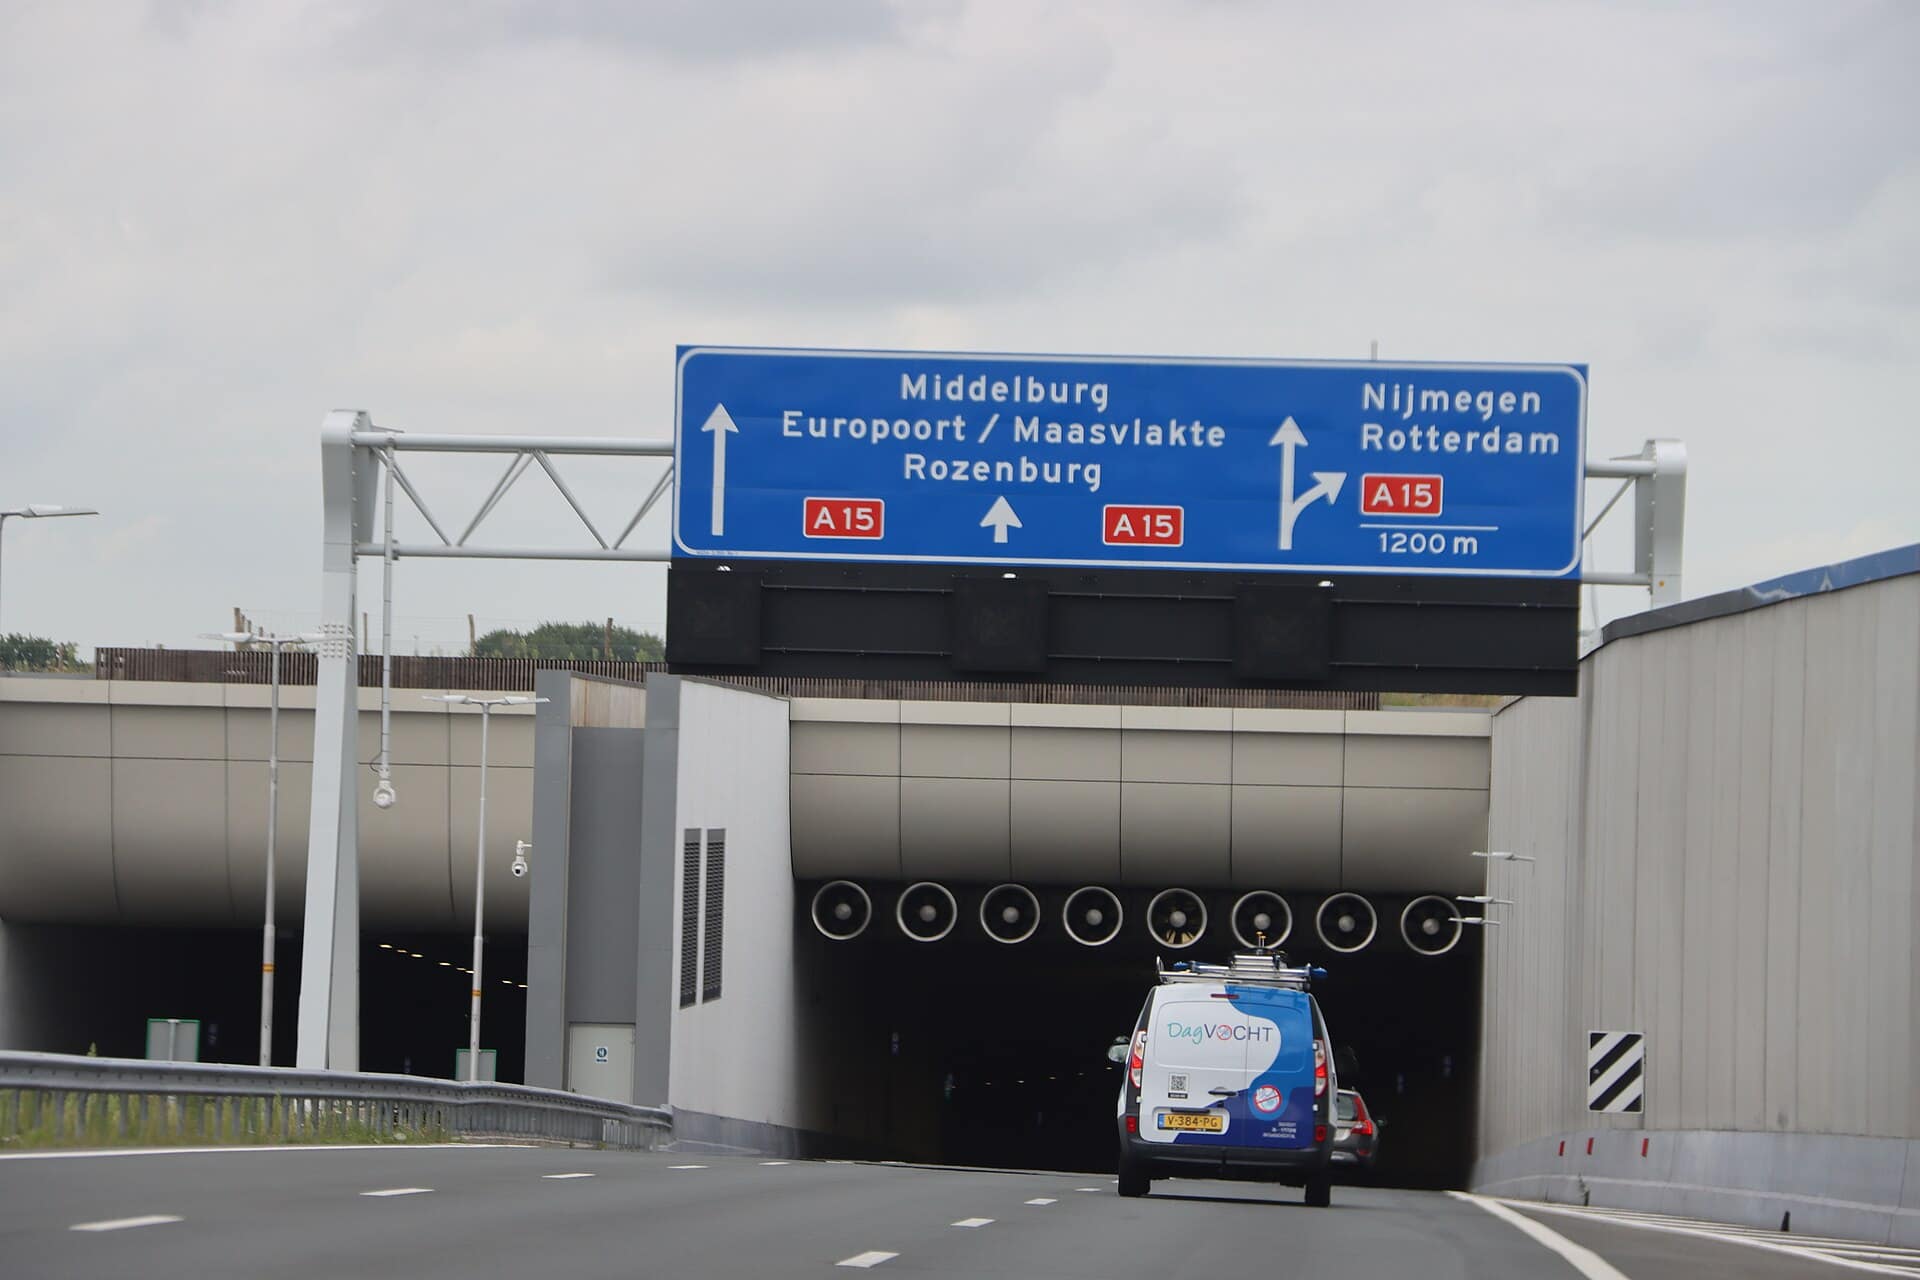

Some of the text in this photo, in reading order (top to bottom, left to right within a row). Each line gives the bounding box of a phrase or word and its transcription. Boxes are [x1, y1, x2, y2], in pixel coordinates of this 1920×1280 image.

[902, 373, 1109, 412] Middelburg
[1362, 383, 1541, 420] Nijmegen
[782, 410, 1226, 448] Europoort / Maasvlakte
[1362, 423, 1560, 455] Rotterdam
[904, 453, 1101, 492] Rozenburg
[1379, 532, 1478, 554] 1200 m
[1167, 1115, 1218, 1128] V-384-PG
